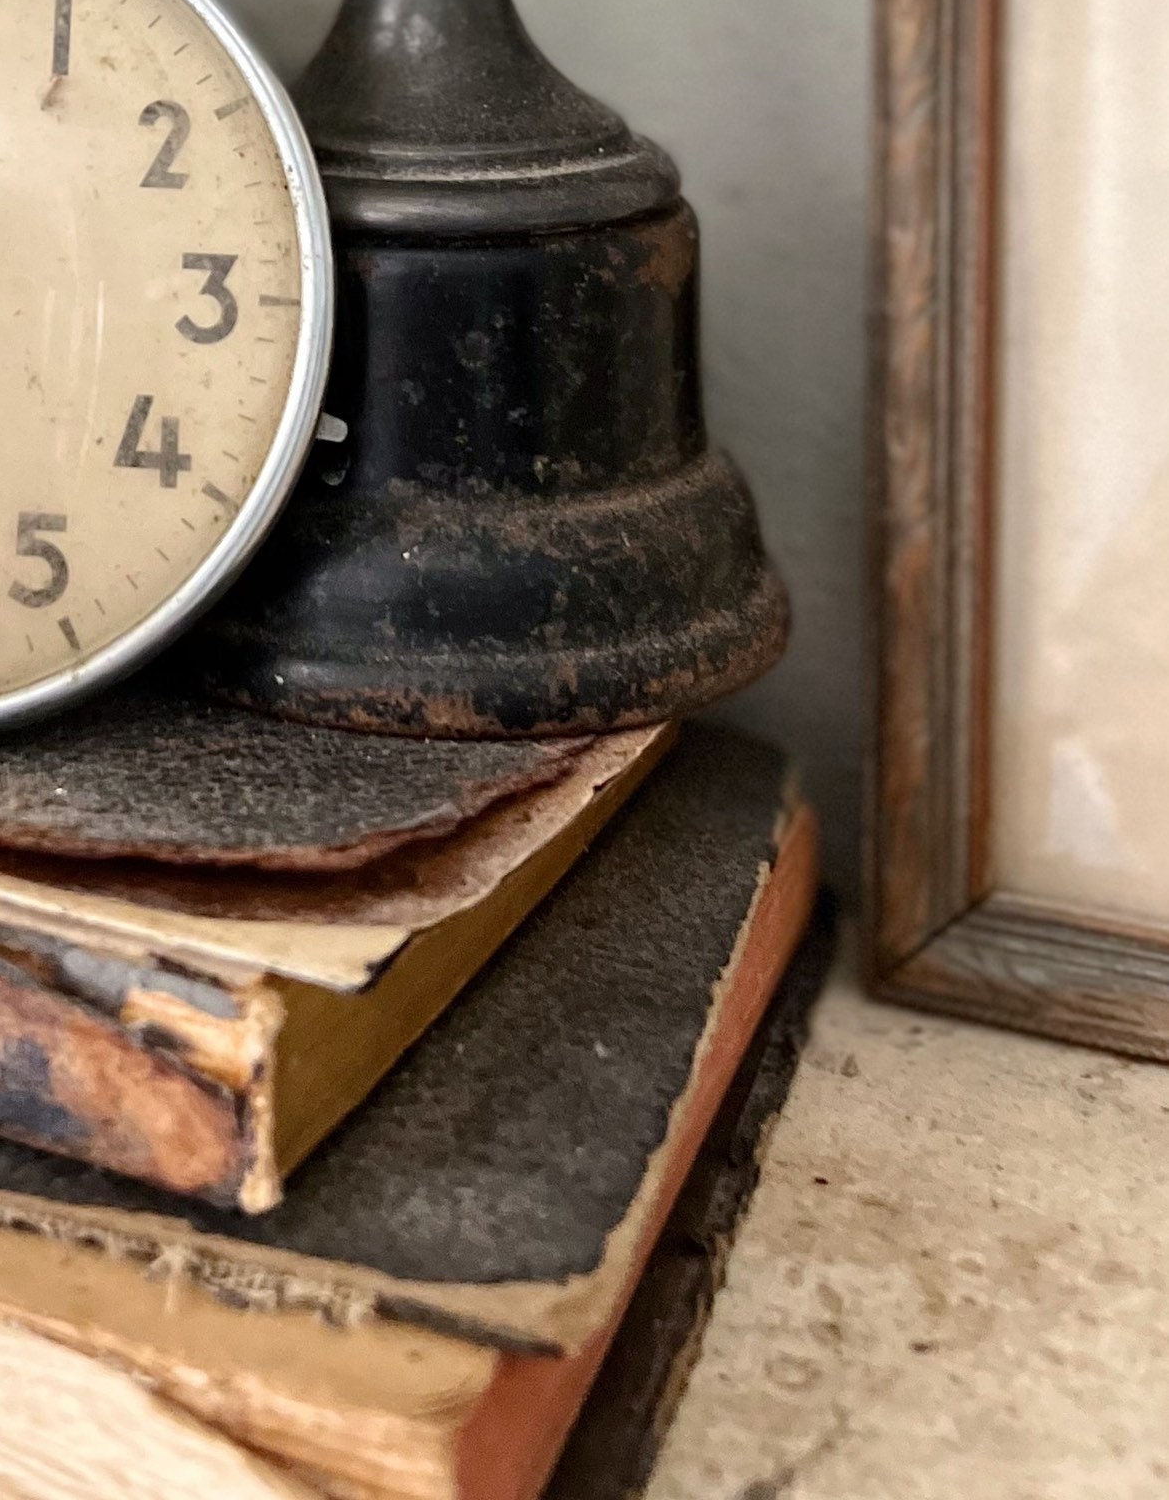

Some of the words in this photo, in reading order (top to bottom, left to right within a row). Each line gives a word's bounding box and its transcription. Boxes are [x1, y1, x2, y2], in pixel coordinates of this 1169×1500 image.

[136, 100, 193, 189] 2
[174, 253, 240, 345] 3
[112, 394, 193, 489] 4
[7, 512, 71, 608] 5
